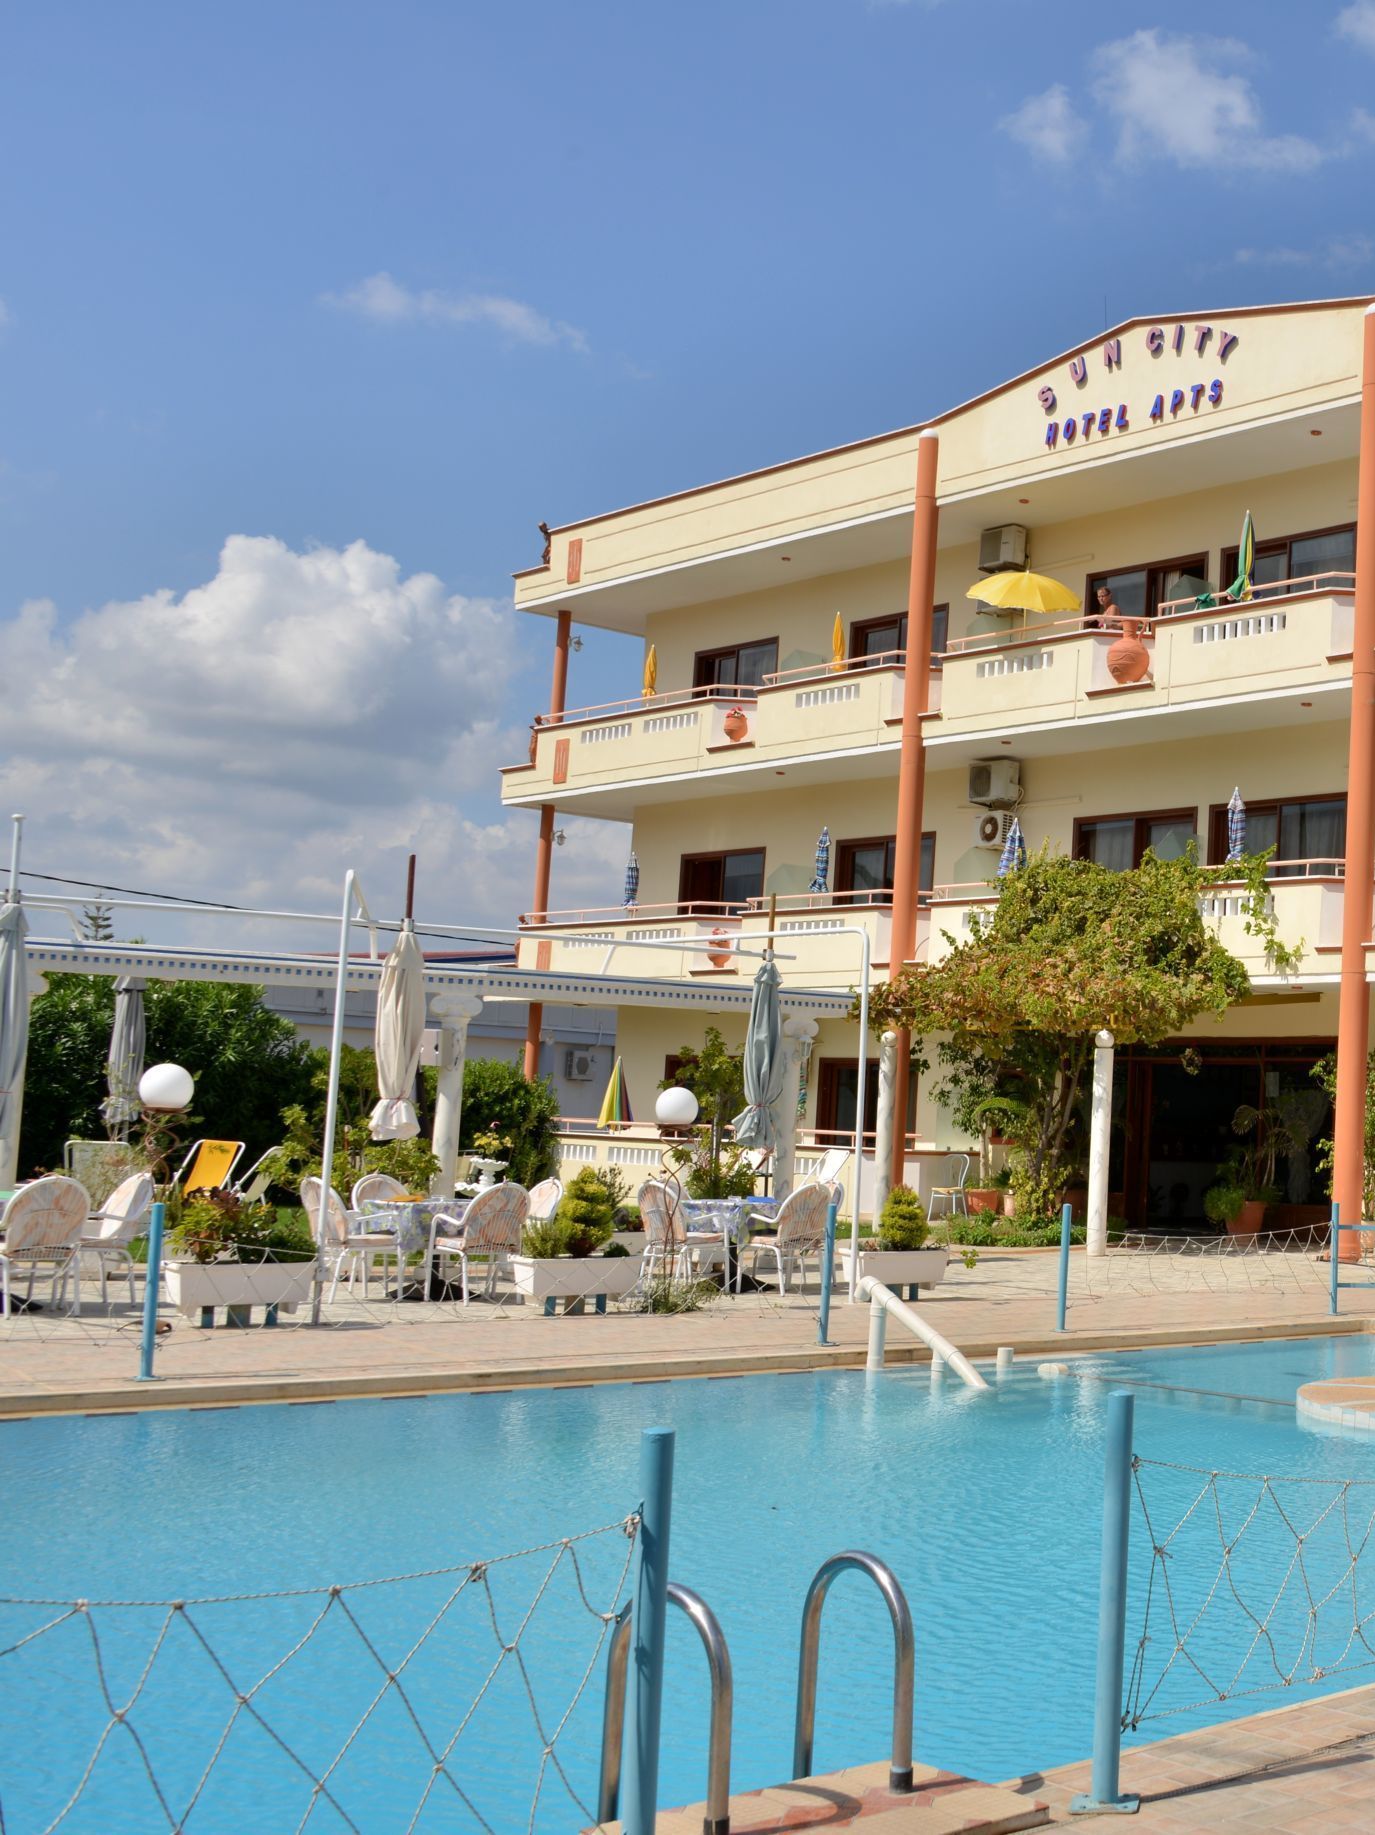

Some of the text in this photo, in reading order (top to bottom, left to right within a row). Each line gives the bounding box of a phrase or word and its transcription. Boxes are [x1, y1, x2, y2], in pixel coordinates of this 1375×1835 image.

[1038, 324, 1239, 411] SUN CITY
[1045, 379, 1223, 447] HOTEL APTS
